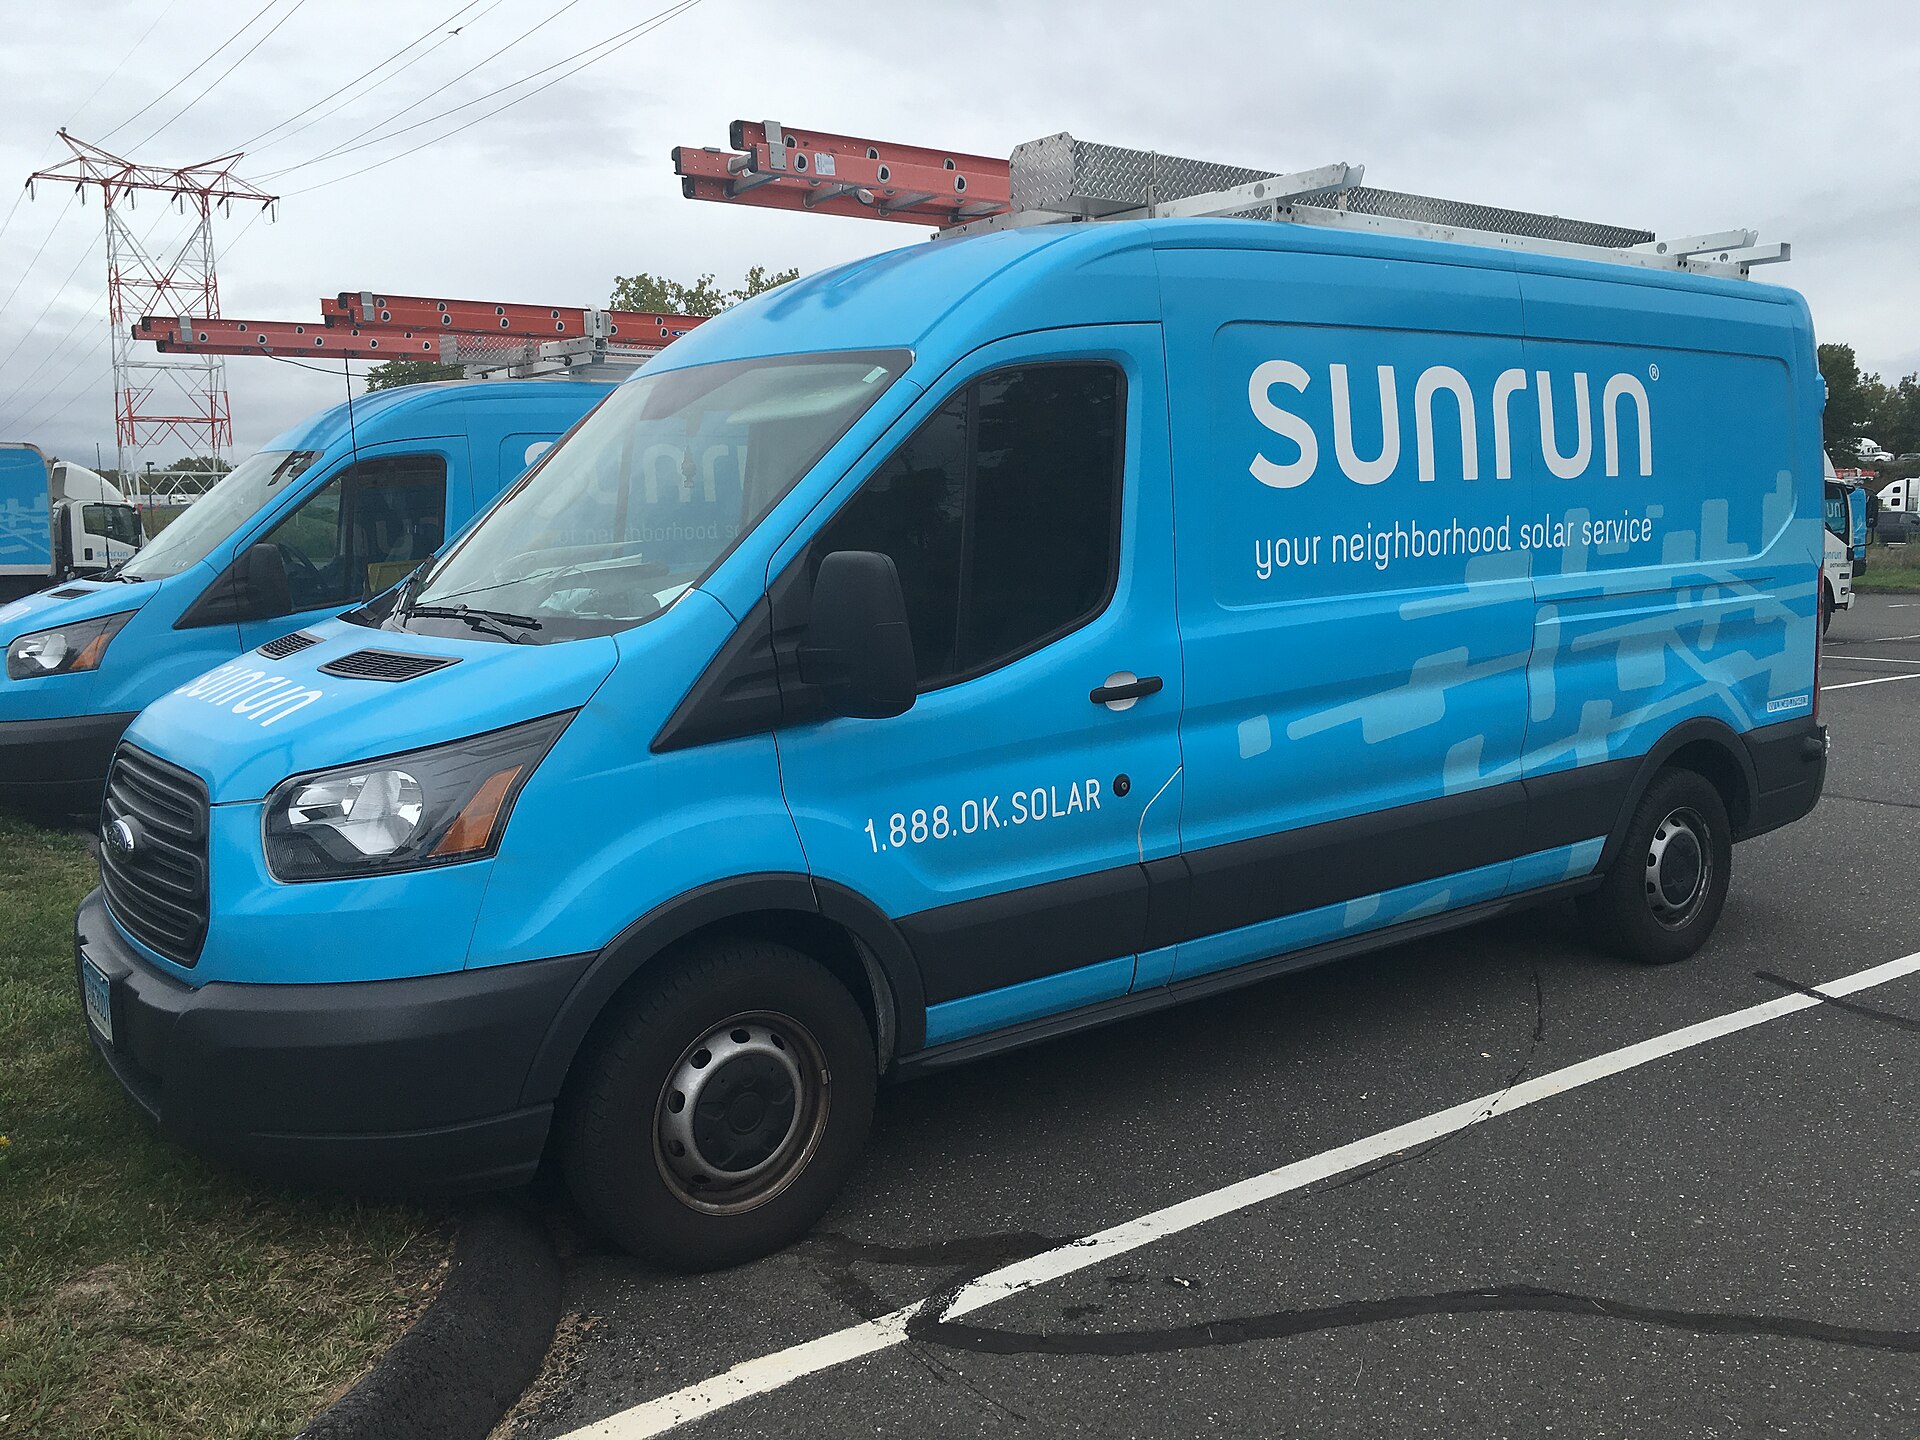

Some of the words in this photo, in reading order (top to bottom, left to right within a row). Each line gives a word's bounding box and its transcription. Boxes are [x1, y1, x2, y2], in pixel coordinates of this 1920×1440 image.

[1255, 534, 1320, 580] your
[1331, 514, 1512, 571] neighborhood
[1519, 513, 1575, 549] solar
[1581, 509, 1653, 546] service
[173, 665, 324, 727] sunrun
[864, 778, 1101, 853] 1.888.OK.SOLAR
